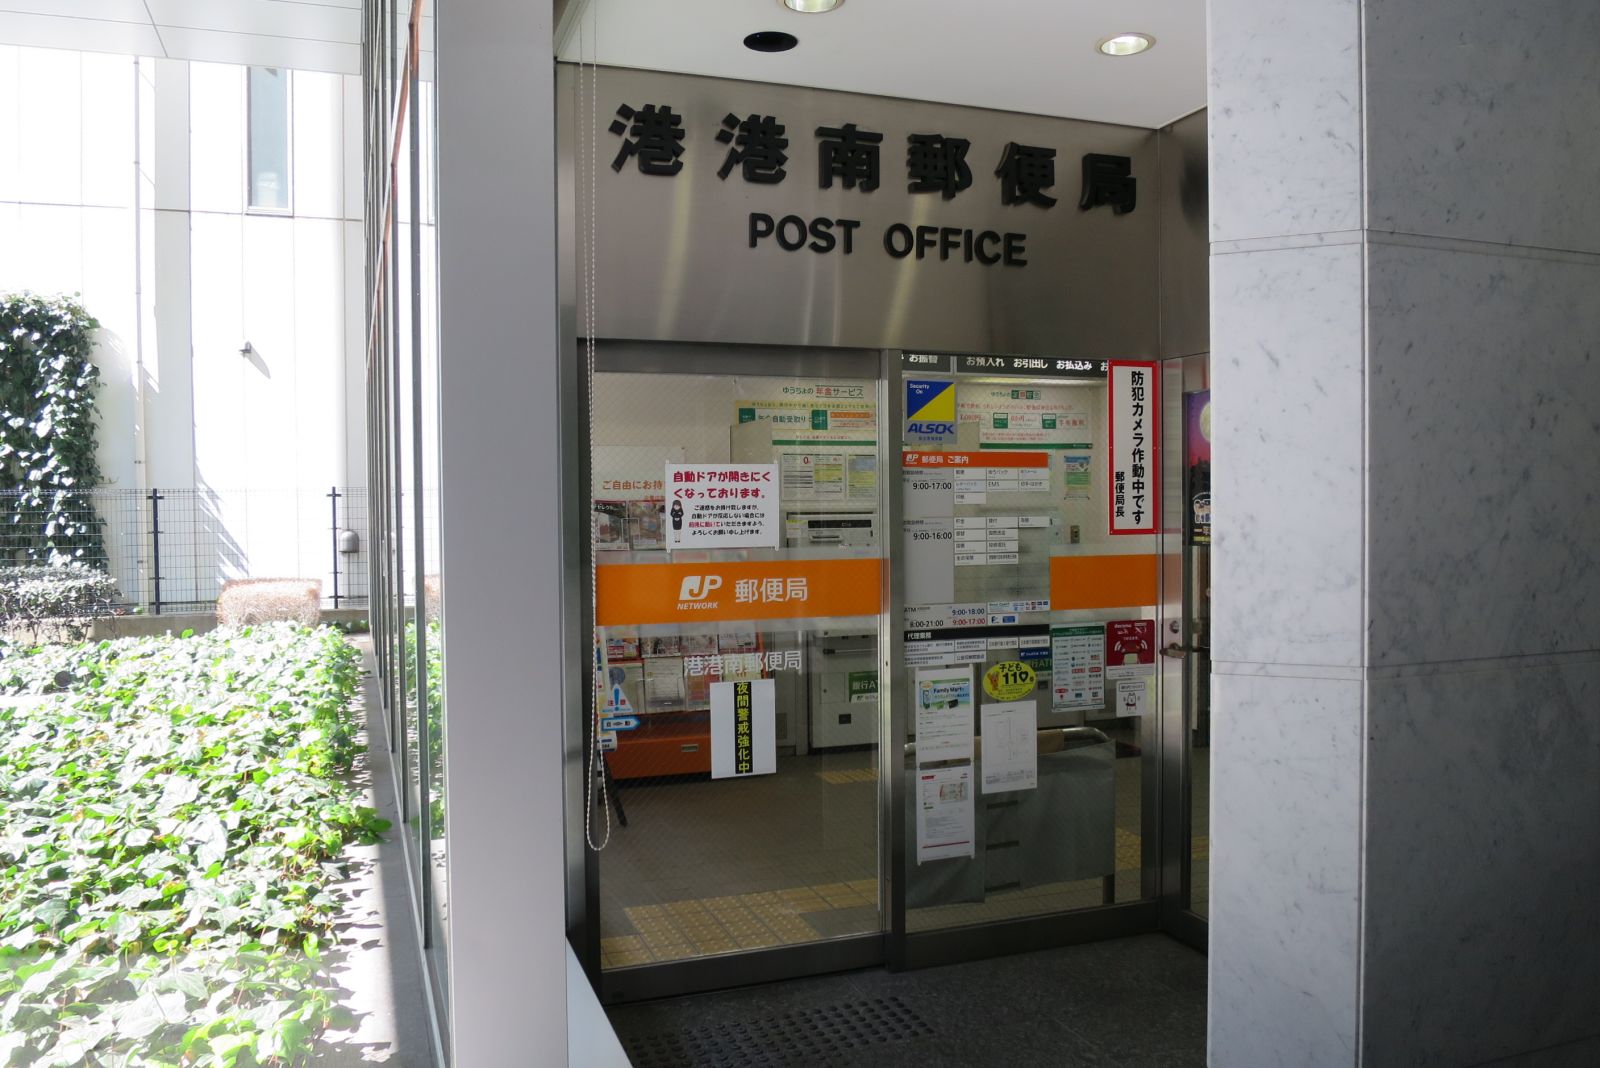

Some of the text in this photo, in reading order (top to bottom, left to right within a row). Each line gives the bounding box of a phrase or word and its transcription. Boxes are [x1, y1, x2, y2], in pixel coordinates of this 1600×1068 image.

[608, 103, 1137, 215] 港港南郵便局
[748, 212, 1028, 266] POST OFFICE
[966, 356, 1005, 367] お預入れ
[1013, 358, 1048, 369] お引出し
[1056, 360, 1093, 370] お払込み
[907, 423, 954, 435] ALSOK
[1131, 371, 1145, 525] 防犯カメラ作動中です
[921, 455, 944, 464] 郵便局
[947, 455, 969, 464] ご案内
[673, 470, 771, 483] 自動ドアが開きにく
[912, 482, 952, 490] 9:00-17:00
[673, 488, 765, 499] くなっております。
[1115, 471, 1125, 518] 郵便局長
[913, 532, 952, 541] 9:00-16:00
[734, 577, 809, 603] 郵便局
[677, 601, 718, 610] NETWORK
[952, 608, 985, 616] 9:00-18:00
[952, 618, 985, 626] 9:00-17:00
[683, 650, 803, 676] 港港南郵便局
[999, 662, 1022, 672] 子ども
[736, 681, 750, 774] 夜間警戒強化中
